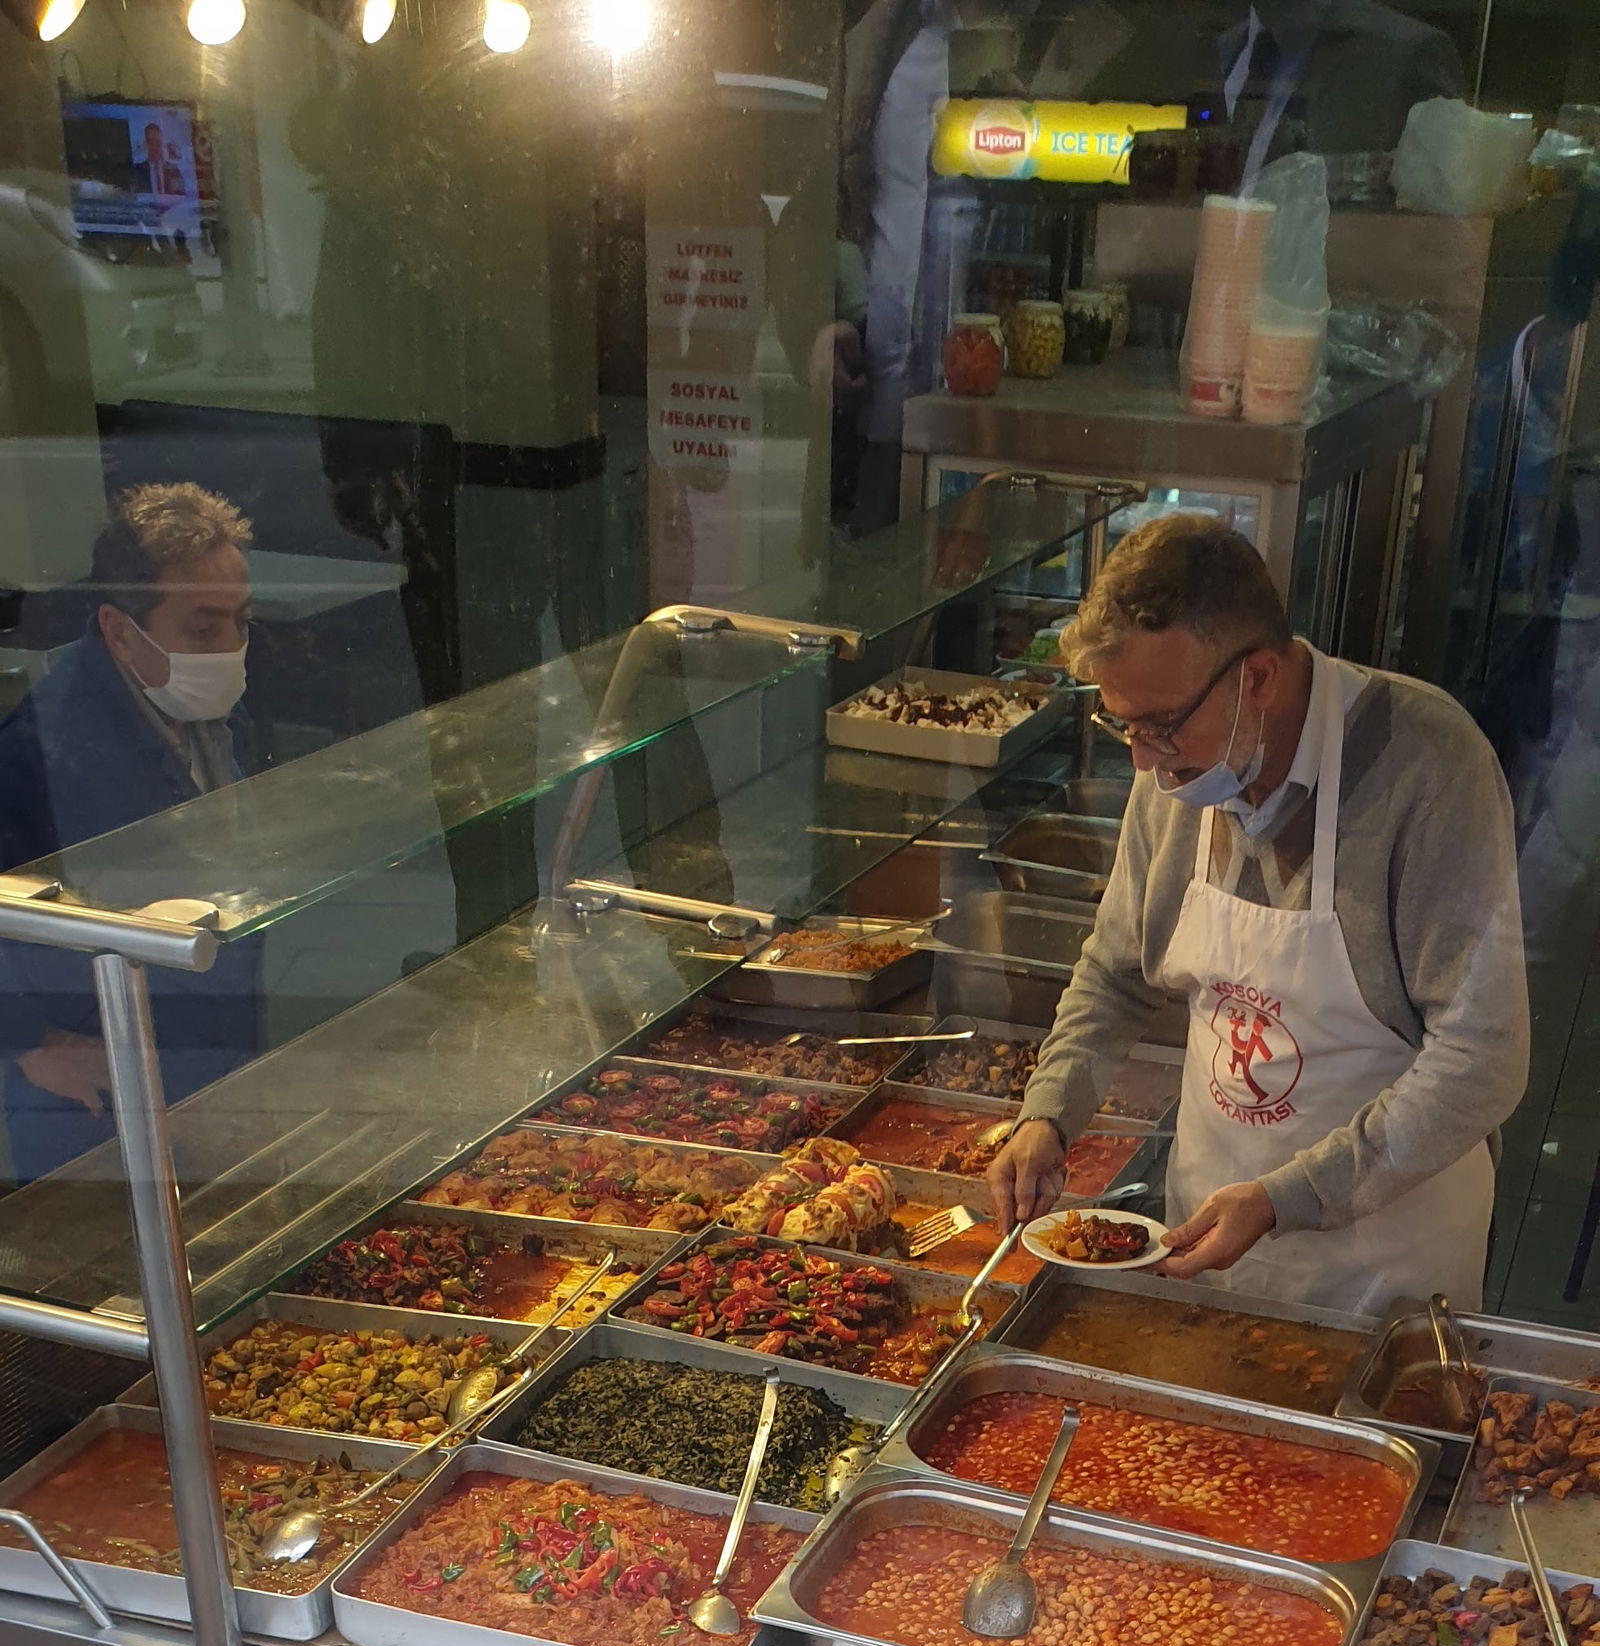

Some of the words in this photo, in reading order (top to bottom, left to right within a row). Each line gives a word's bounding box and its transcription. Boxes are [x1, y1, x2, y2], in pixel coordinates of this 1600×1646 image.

[978, 133, 1021, 151] Lipton
[1052, 131, 1090, 154] ICE
[671, 382, 740, 401] SOSYAL
[1209, 1080, 1297, 1127] LOKANTASI
